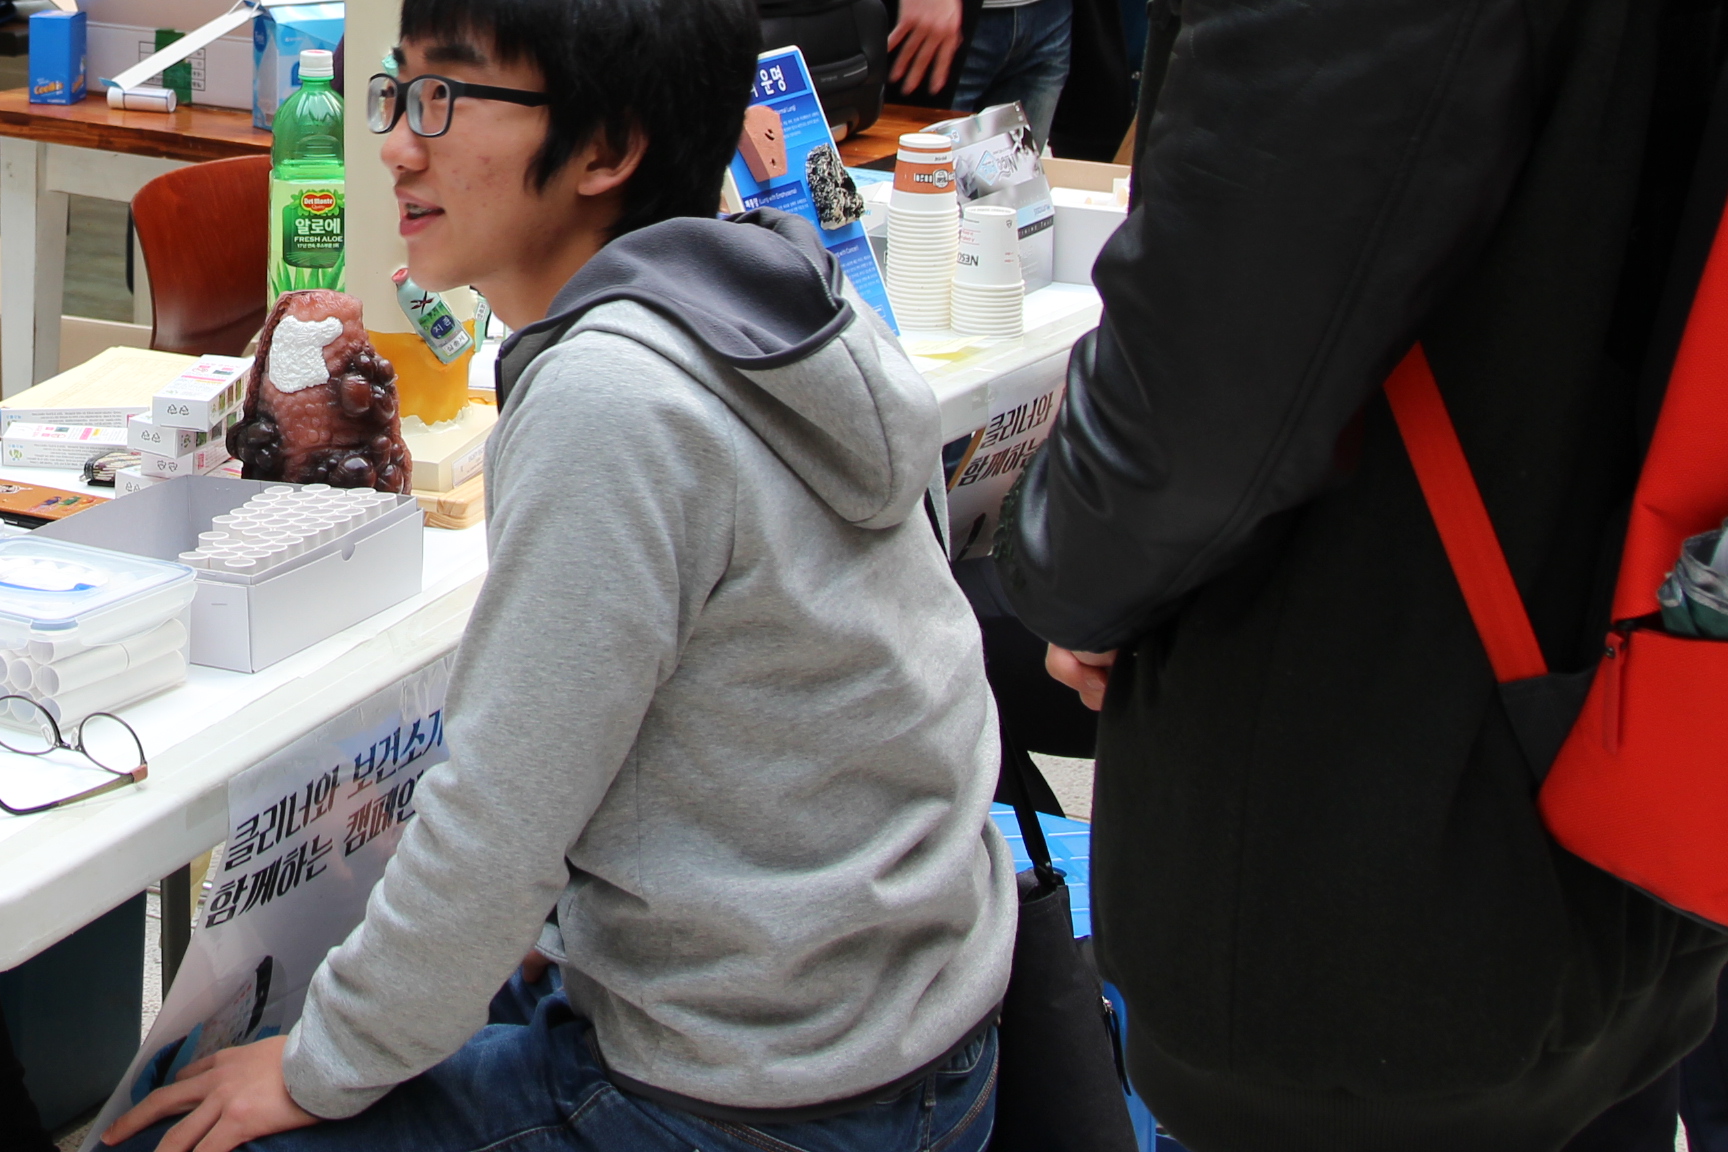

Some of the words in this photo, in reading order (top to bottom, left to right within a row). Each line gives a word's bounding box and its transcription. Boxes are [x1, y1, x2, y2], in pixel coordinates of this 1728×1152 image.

[760, 64, 787, 96] 운명
[294, 235, 321, 243] FRESH
[322, 235, 344, 243] ALOE
[295, 218, 341, 235] 알로에
[980, 391, 1053, 450] 클리너와
[224, 764, 341, 872] 클리너와
[205, 833, 334, 929] 함께하는
